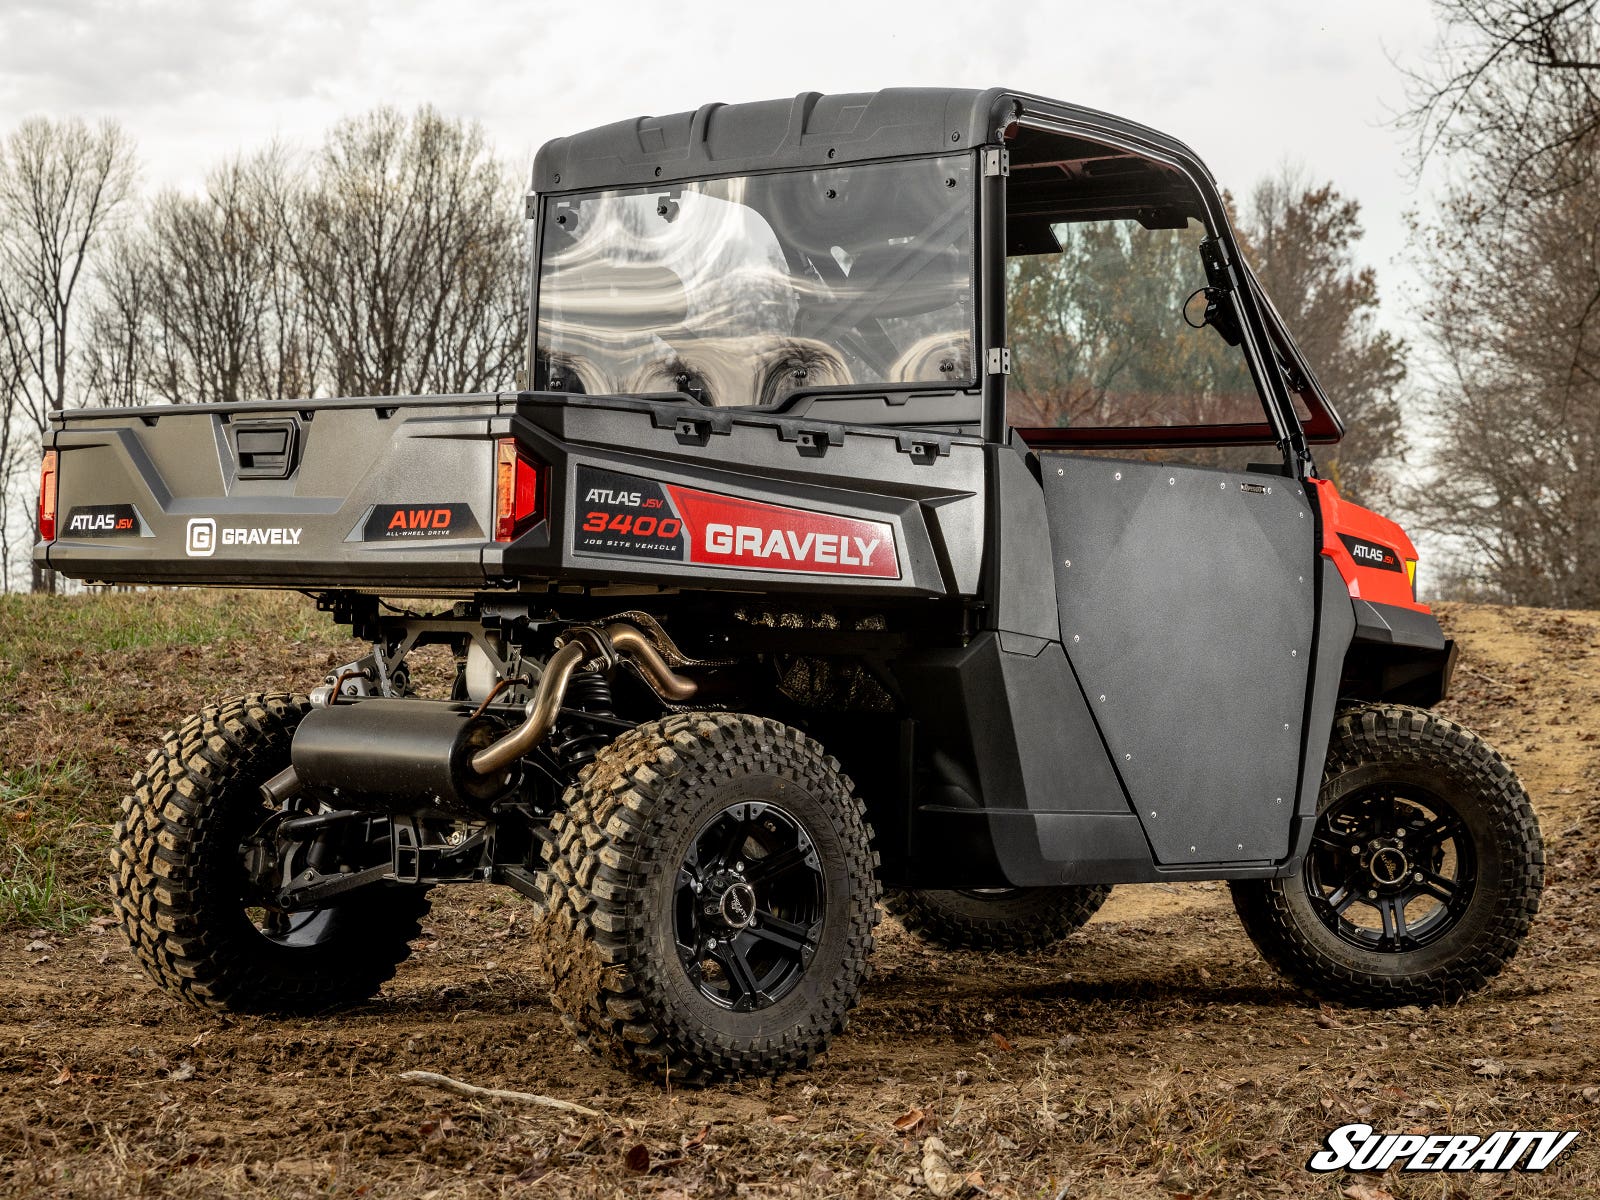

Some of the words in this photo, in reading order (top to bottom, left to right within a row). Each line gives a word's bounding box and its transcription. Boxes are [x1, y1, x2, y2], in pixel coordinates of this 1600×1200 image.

[585, 488, 641, 507] ATLAS
[642, 499, 664, 509] JSV
[70, 514, 114, 530] ATLAS
[115, 518, 133, 529] JSV
[387, 509, 452, 529] AWD
[582, 511, 682, 539] 3400
[221, 528, 302, 545] GRAVELY
[606, 540, 631, 548] SITE
[635, 543, 677, 551] VEHICLE
[705, 523, 881, 567] GRAVELY
[1353, 544, 1383, 562] ATLAS
